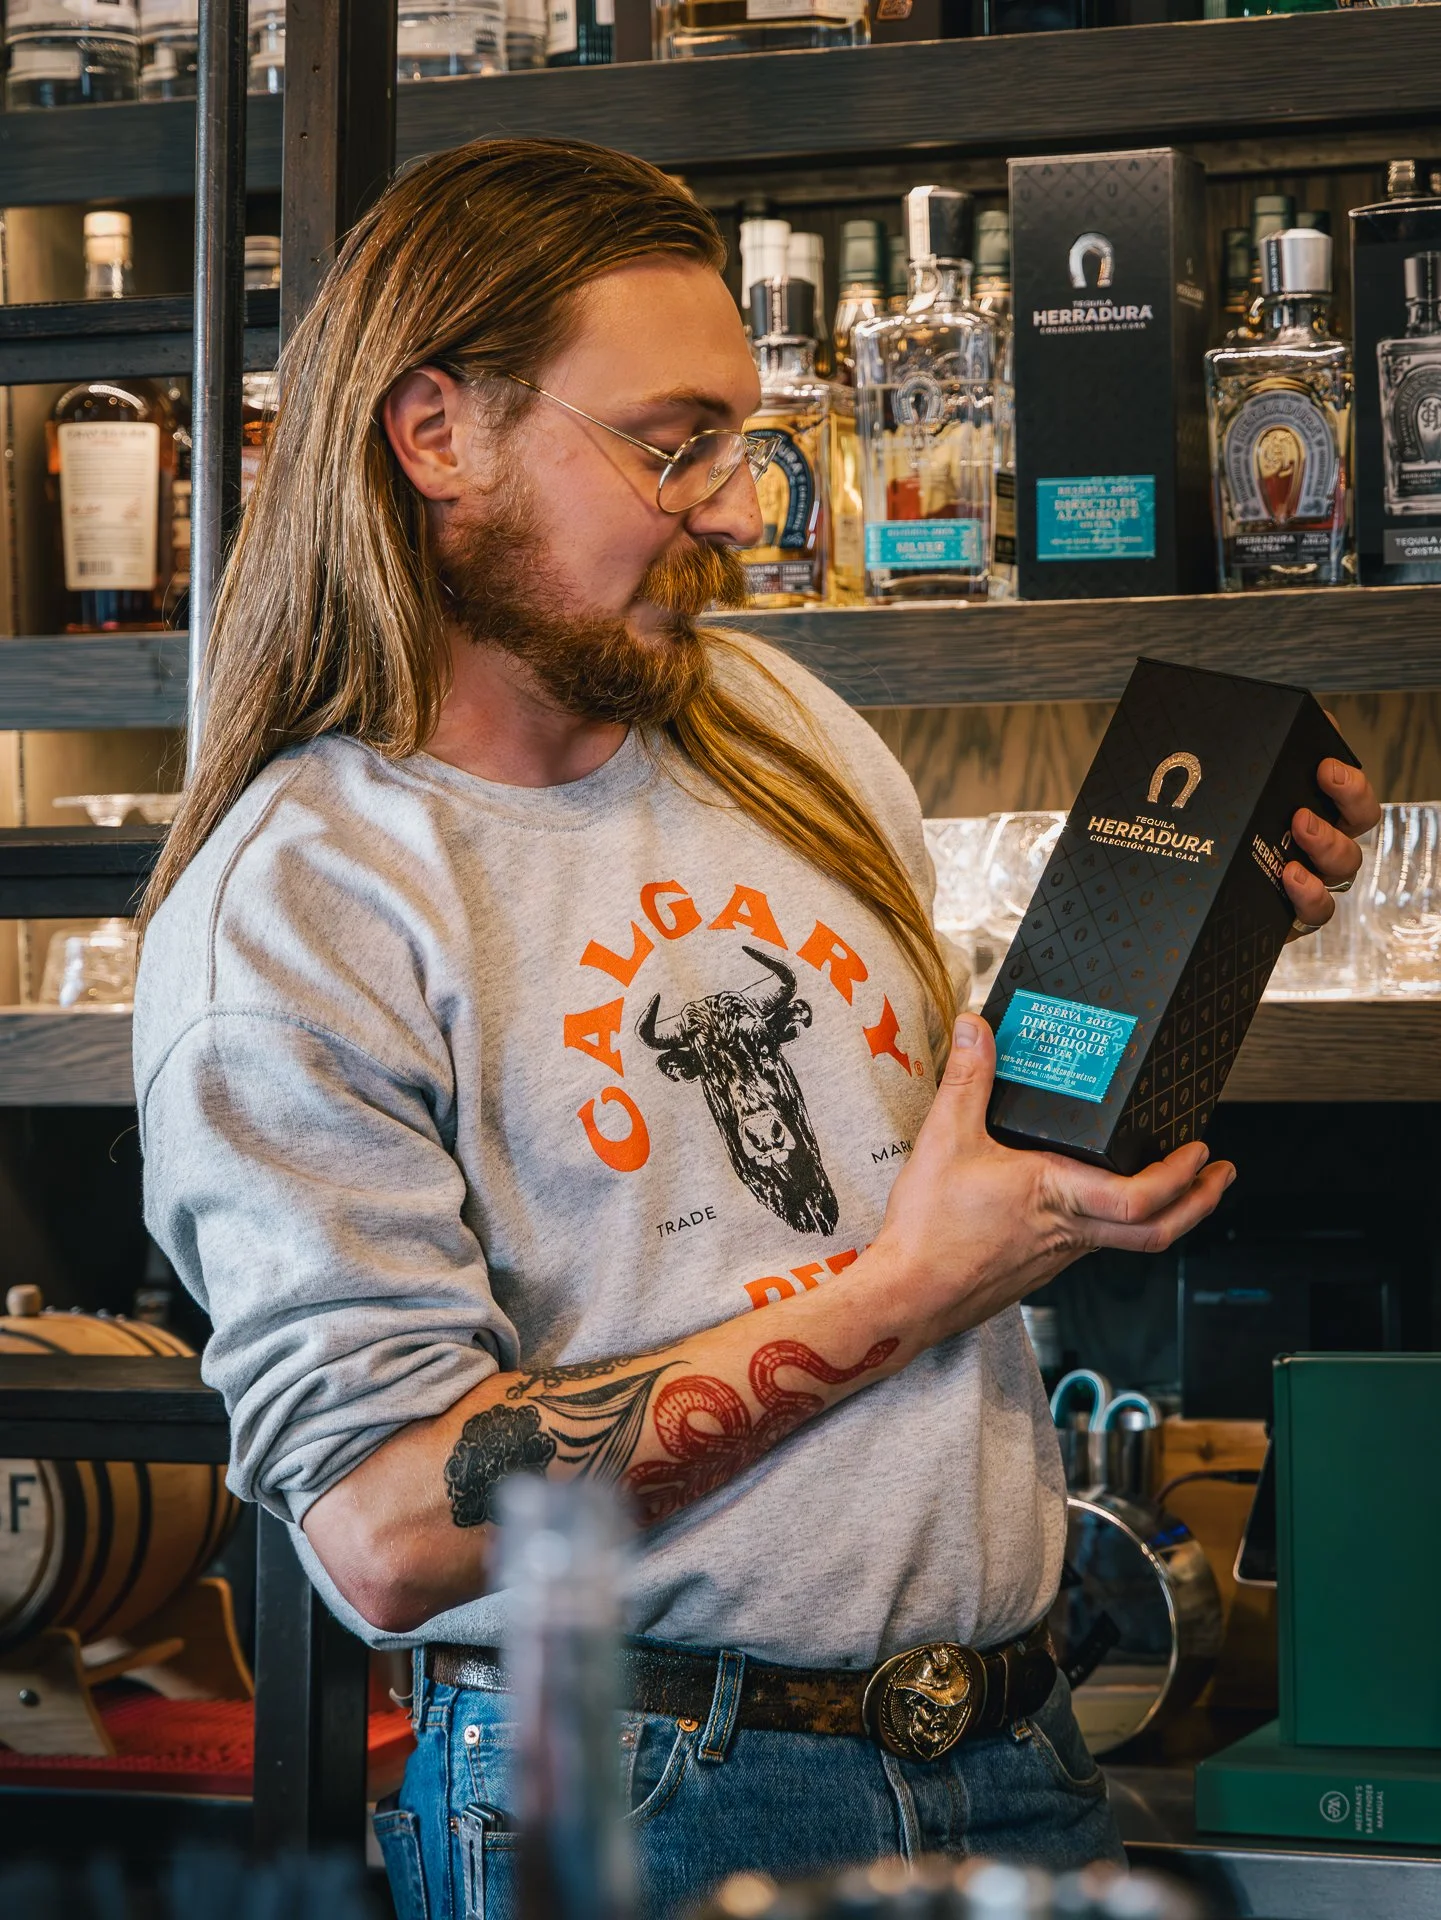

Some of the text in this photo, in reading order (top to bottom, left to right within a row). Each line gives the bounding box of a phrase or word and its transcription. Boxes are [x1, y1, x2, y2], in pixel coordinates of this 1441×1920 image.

[1033, 305, 1153, 326] HERRADURA
[1395, 536, 1438, 547] TEQUILA
[1404, 546, 1441, 557] CRISTA
[1087, 816, 1215, 855] HERRADURA
[1135, 815, 1175, 830] TEQUILA
[1089, 834, 1200, 863] COLECCIÓN DE LA CASA
[563, 880, 912, 1172] CALGARY
[1031, 1002, 1081, 1022] RESERVA
[1018, 1027, 1106, 1057] ALAMBIQUE
[1020, 1015, 1111, 1045] DIRECTO DE
[1037, 1044, 1073, 1058] SILVER
[656, 1206, 717, 1237] TRADE
[1365, 1784, 1373, 1834] BARTENDER
[1376, 1791, 1384, 1829] MANUAL
